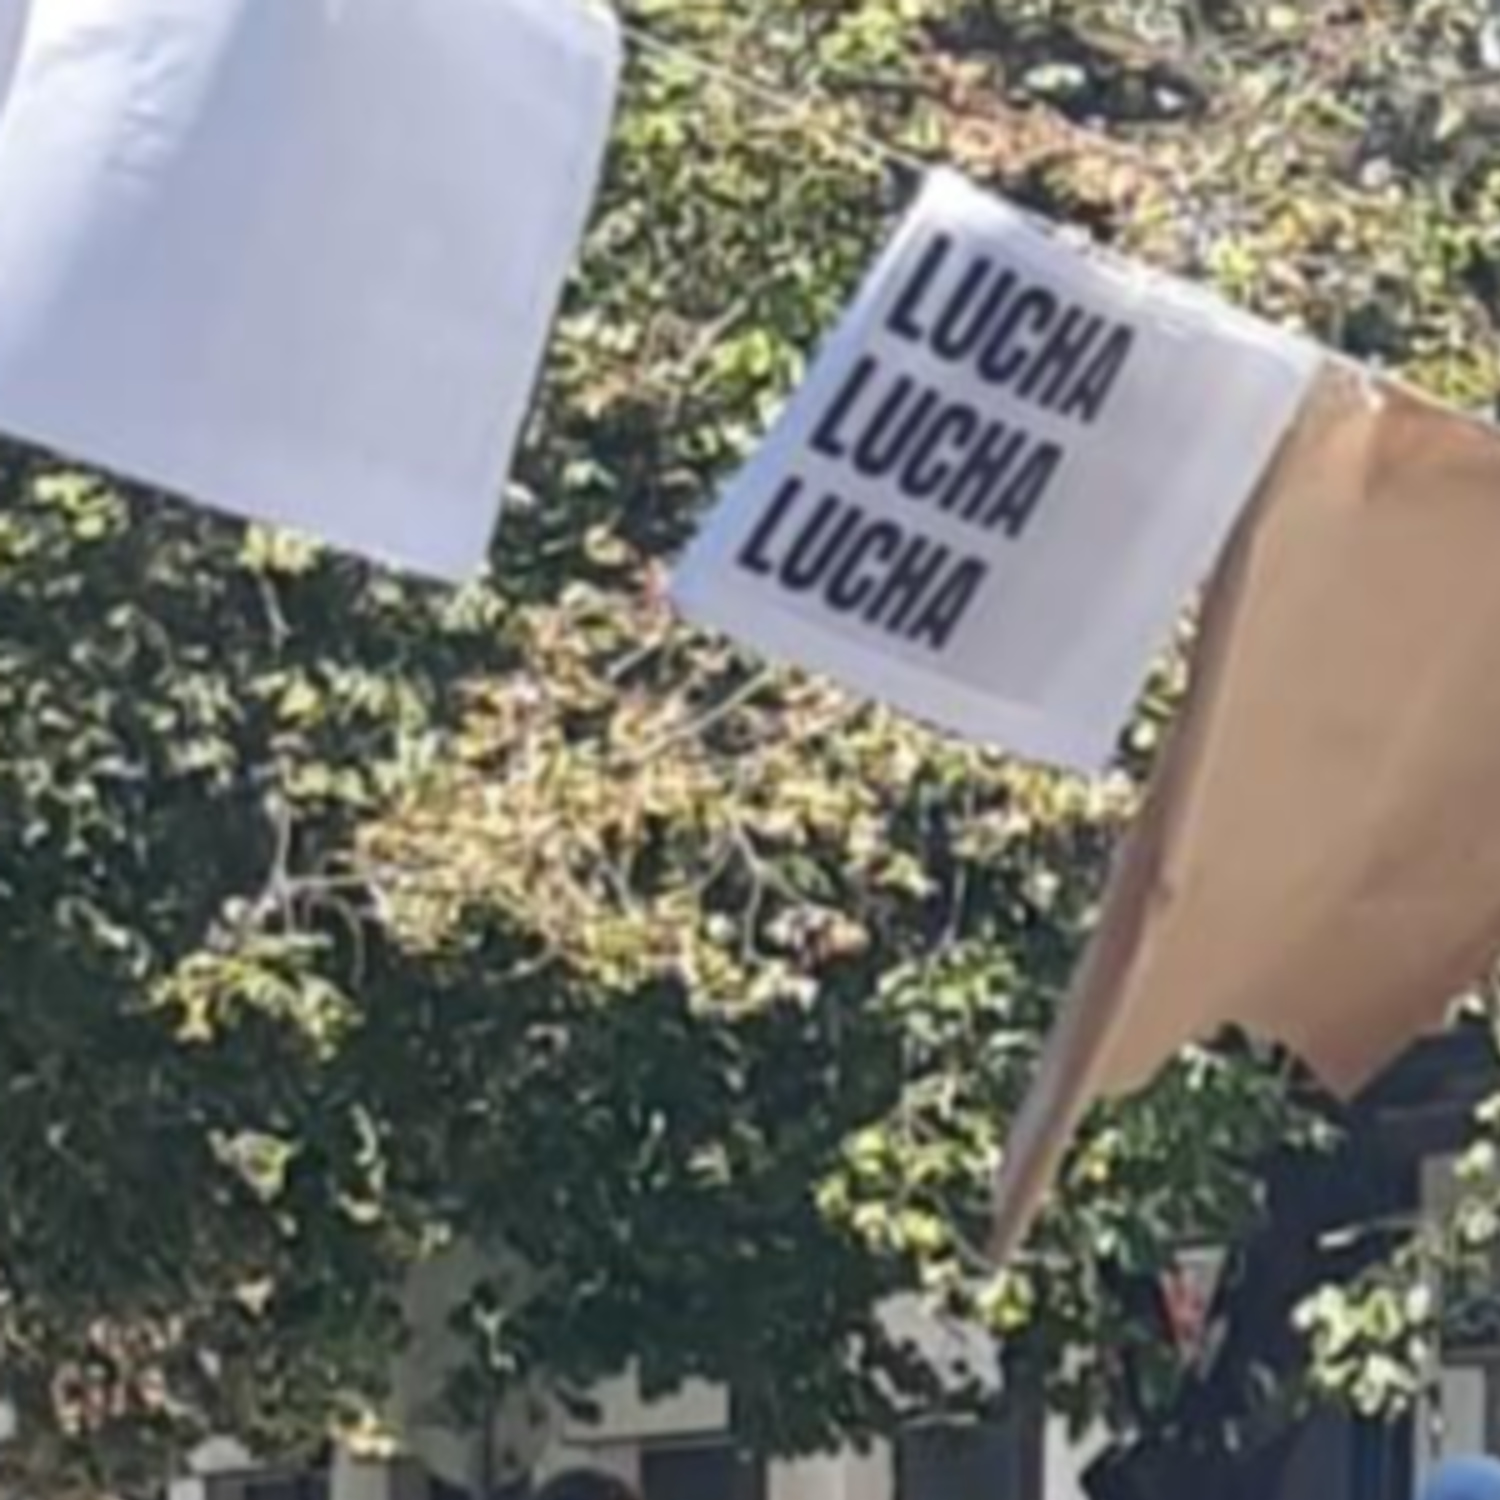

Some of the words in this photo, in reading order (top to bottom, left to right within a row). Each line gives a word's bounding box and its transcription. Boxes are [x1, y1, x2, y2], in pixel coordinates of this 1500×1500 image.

[884, 234, 1135, 424] LUCHA
[808, 354, 1064, 539] LUCHA
[736, 476, 990, 651] LUCHA
